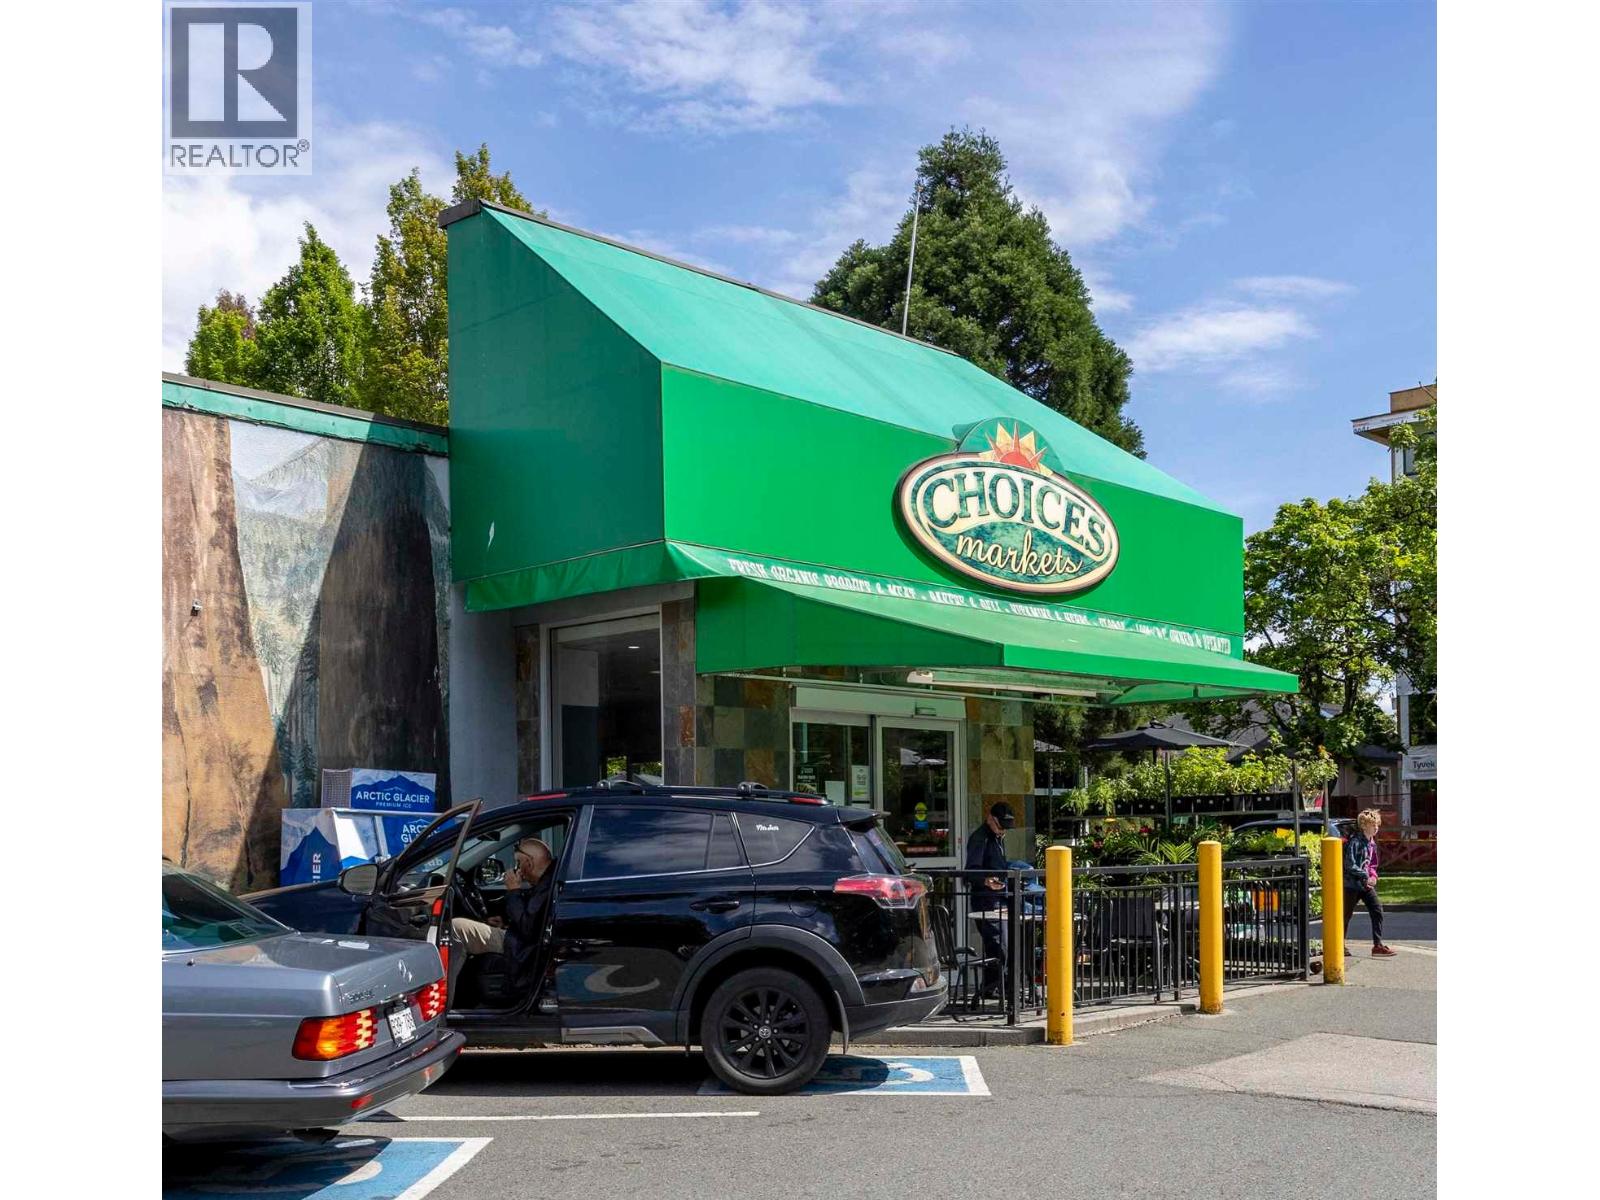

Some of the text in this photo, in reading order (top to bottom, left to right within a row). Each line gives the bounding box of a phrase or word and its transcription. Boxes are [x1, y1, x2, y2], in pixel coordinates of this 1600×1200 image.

[923, 471, 1106, 557] CHOICES
[956, 529, 1083, 576] markets
[727, 558, 767, 579] FRESH
[770, 565, 820, 586] ORGANIC
[356, 791, 430, 803] ARCTIC GLACIER
